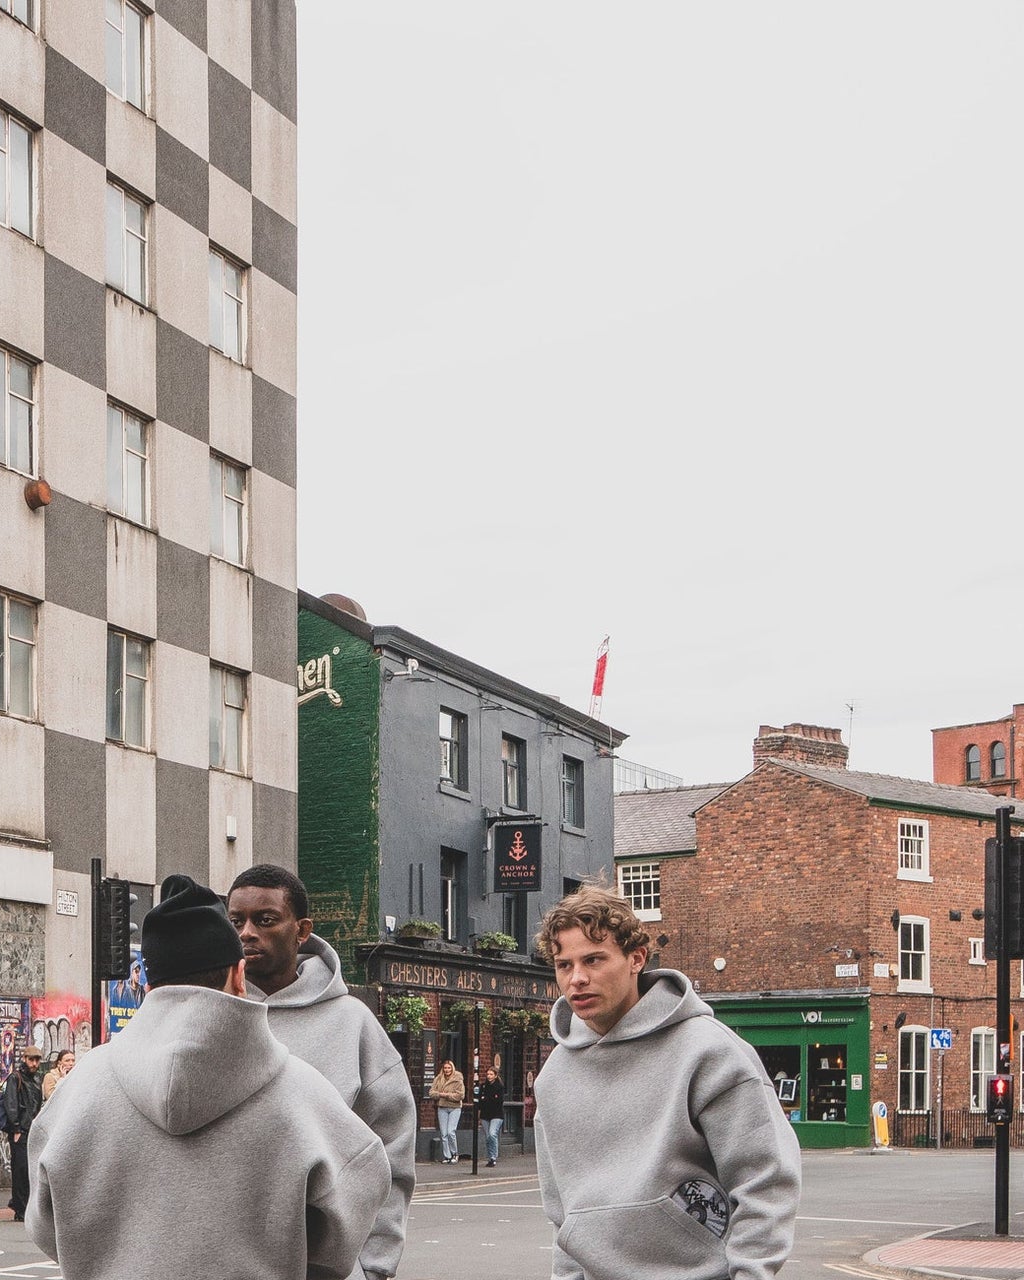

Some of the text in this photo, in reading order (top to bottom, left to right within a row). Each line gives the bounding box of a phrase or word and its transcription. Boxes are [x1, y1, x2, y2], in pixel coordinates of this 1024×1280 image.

[58, 902, 76, 912] STREET
[390, 962, 448, 987] CHESTERS
[457, 970, 482, 991] ALES
[546, 981, 561, 1000] WIN
